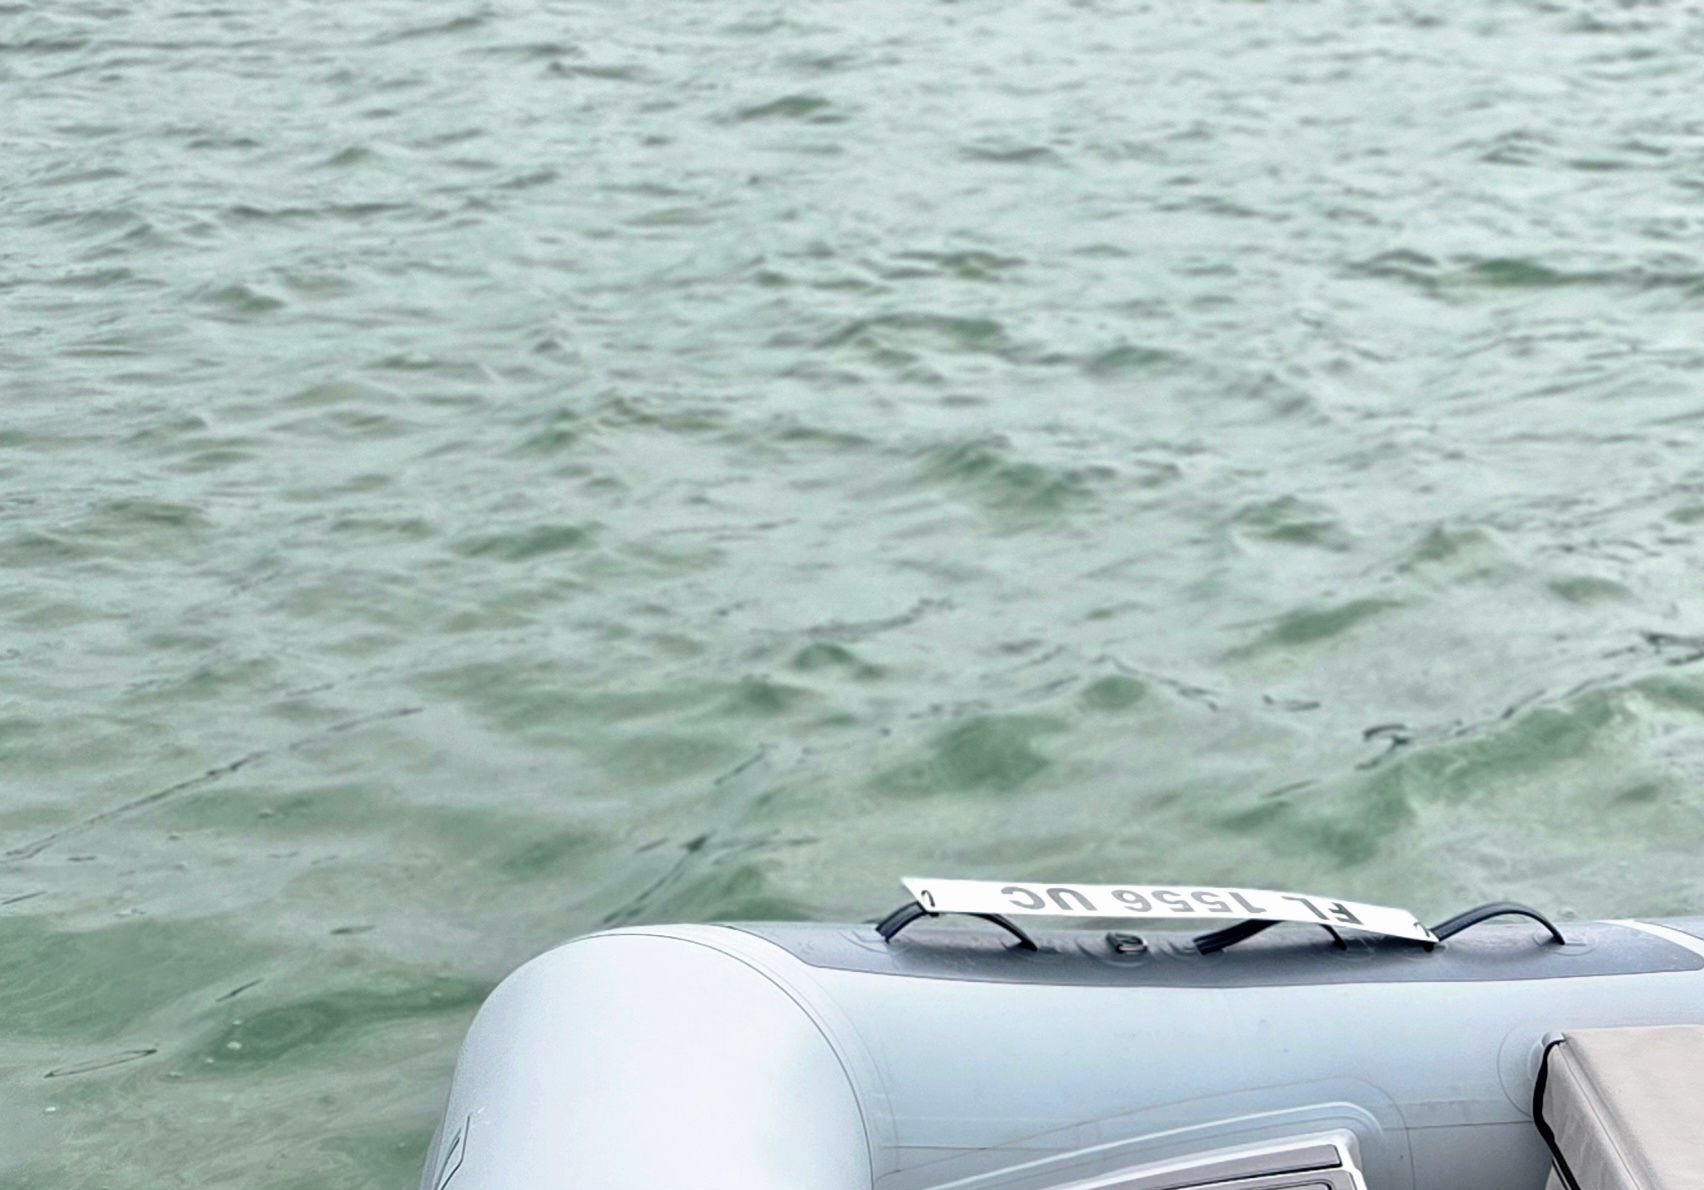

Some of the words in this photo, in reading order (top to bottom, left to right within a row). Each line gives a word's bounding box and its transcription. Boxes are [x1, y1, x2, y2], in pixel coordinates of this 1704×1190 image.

[1000, 887, 1098, 913] UC
[1112, 890, 1265, 914] 1556
[1282, 896, 1363, 924] FL
